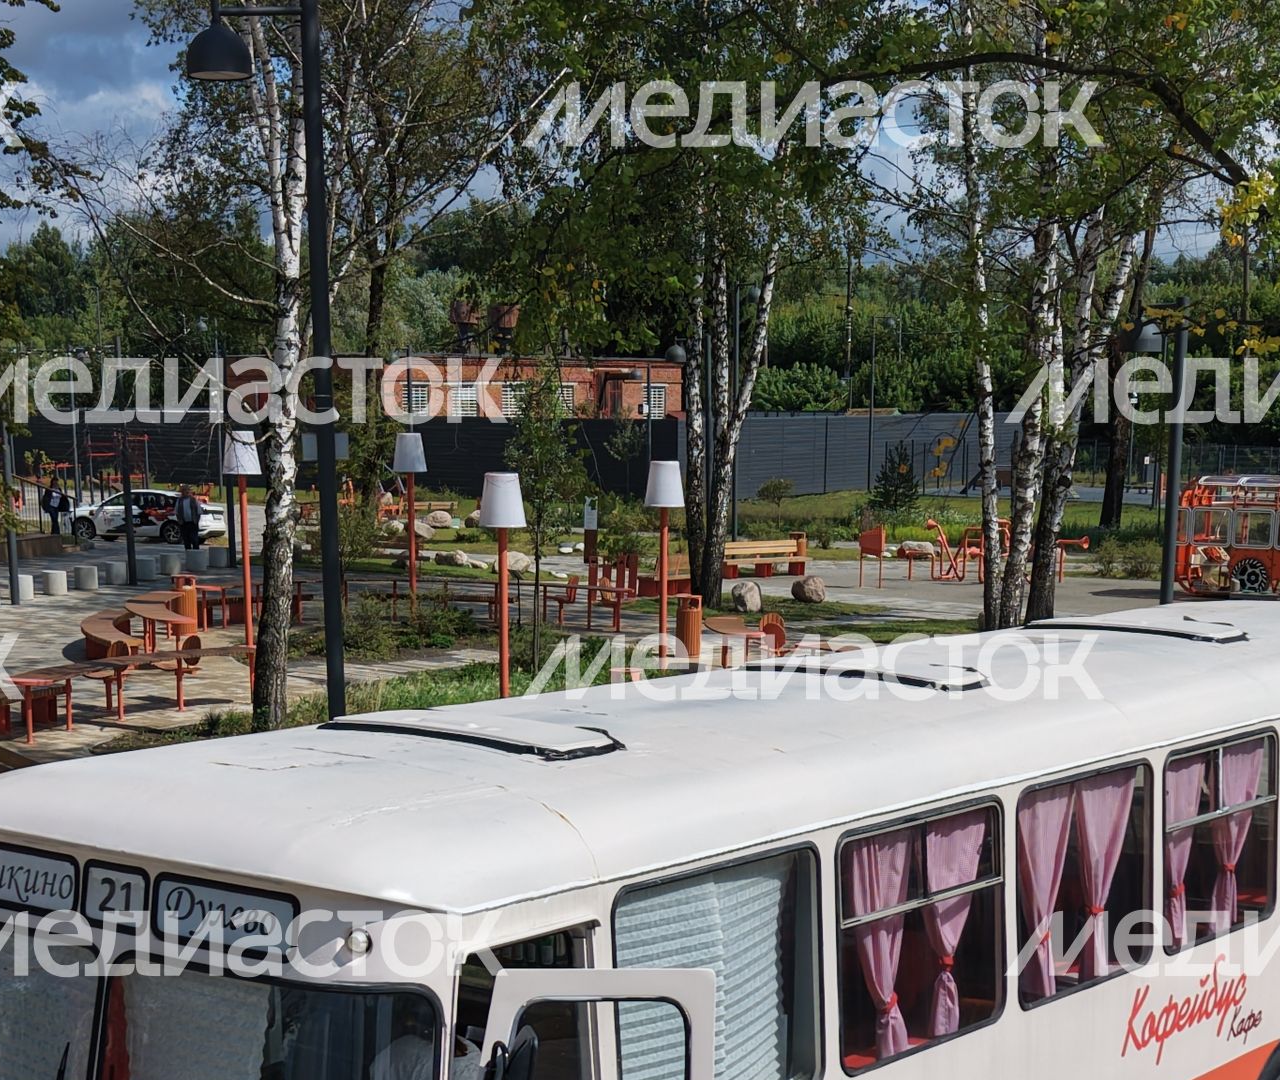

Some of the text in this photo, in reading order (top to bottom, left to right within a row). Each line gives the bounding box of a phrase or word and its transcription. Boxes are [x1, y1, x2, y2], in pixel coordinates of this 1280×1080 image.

[99, 877, 135, 918] 21
[166, 886, 276, 936] Дулево
[1121, 953, 1247, 1065] Кофейбус
